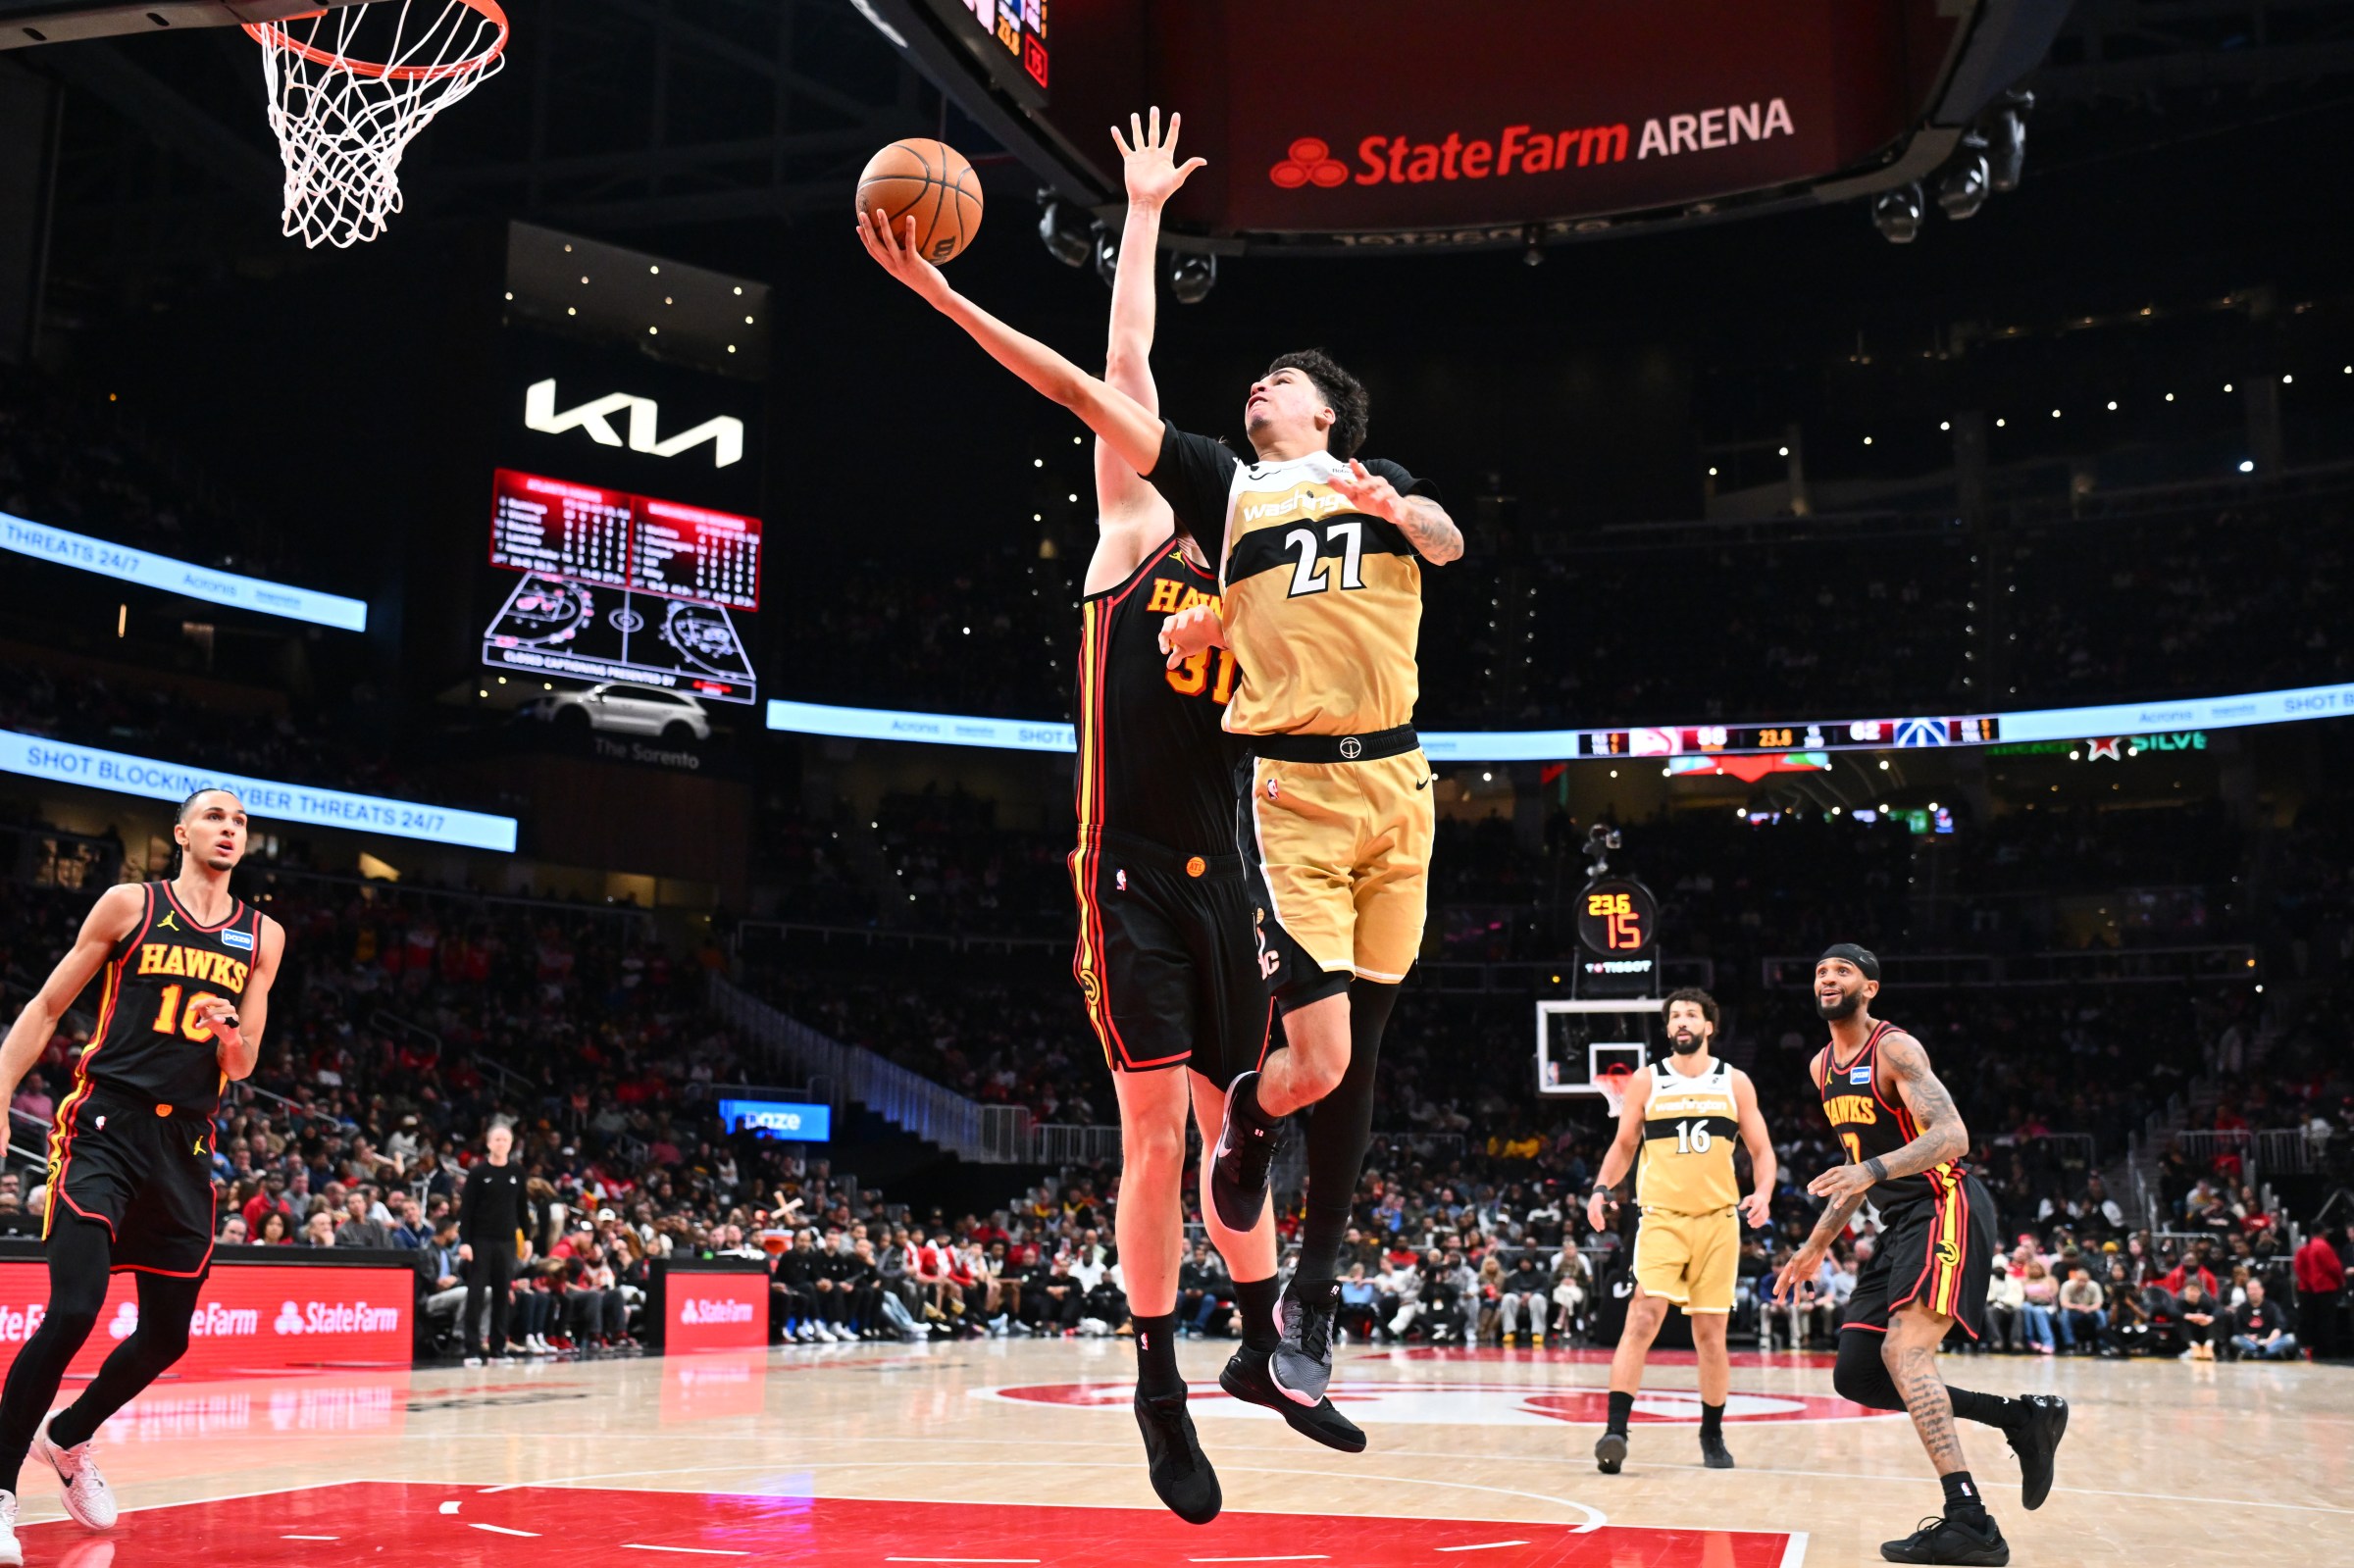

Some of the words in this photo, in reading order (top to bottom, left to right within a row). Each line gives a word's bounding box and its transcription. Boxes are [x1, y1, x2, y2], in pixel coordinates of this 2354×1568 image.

[1637, 98, 1795, 160] ARENA
[525, 378, 743, 469] KIA
[5, 525, 94, 563] THREATS
[100, 550, 140, 573] 24/7
[1284, 522, 1367, 599] 27
[183, 573, 237, 597] Acronis
[2139, 710, 2192, 724] Acronis
[2283, 694, 2334, 714] SHOT
[892, 720, 940, 735] Acronis
[1018, 729, 1062, 745] SHOT
[1849, 721, 1881, 741] 62
[595, 737, 628, 759] The
[633, 742, 699, 770] Sorento
[27, 746, 95, 779] SHOT
[300, 795, 395, 826] THREATS
[401, 810, 445, 833] 24/7
[1588, 893, 1631, 916] 23.6
[1608, 913, 1641, 949] 15
[137, 943, 249, 994] HAWKS
[1655, 1097, 1726, 1114] washington
[1675, 1119, 1712, 1154] 16
